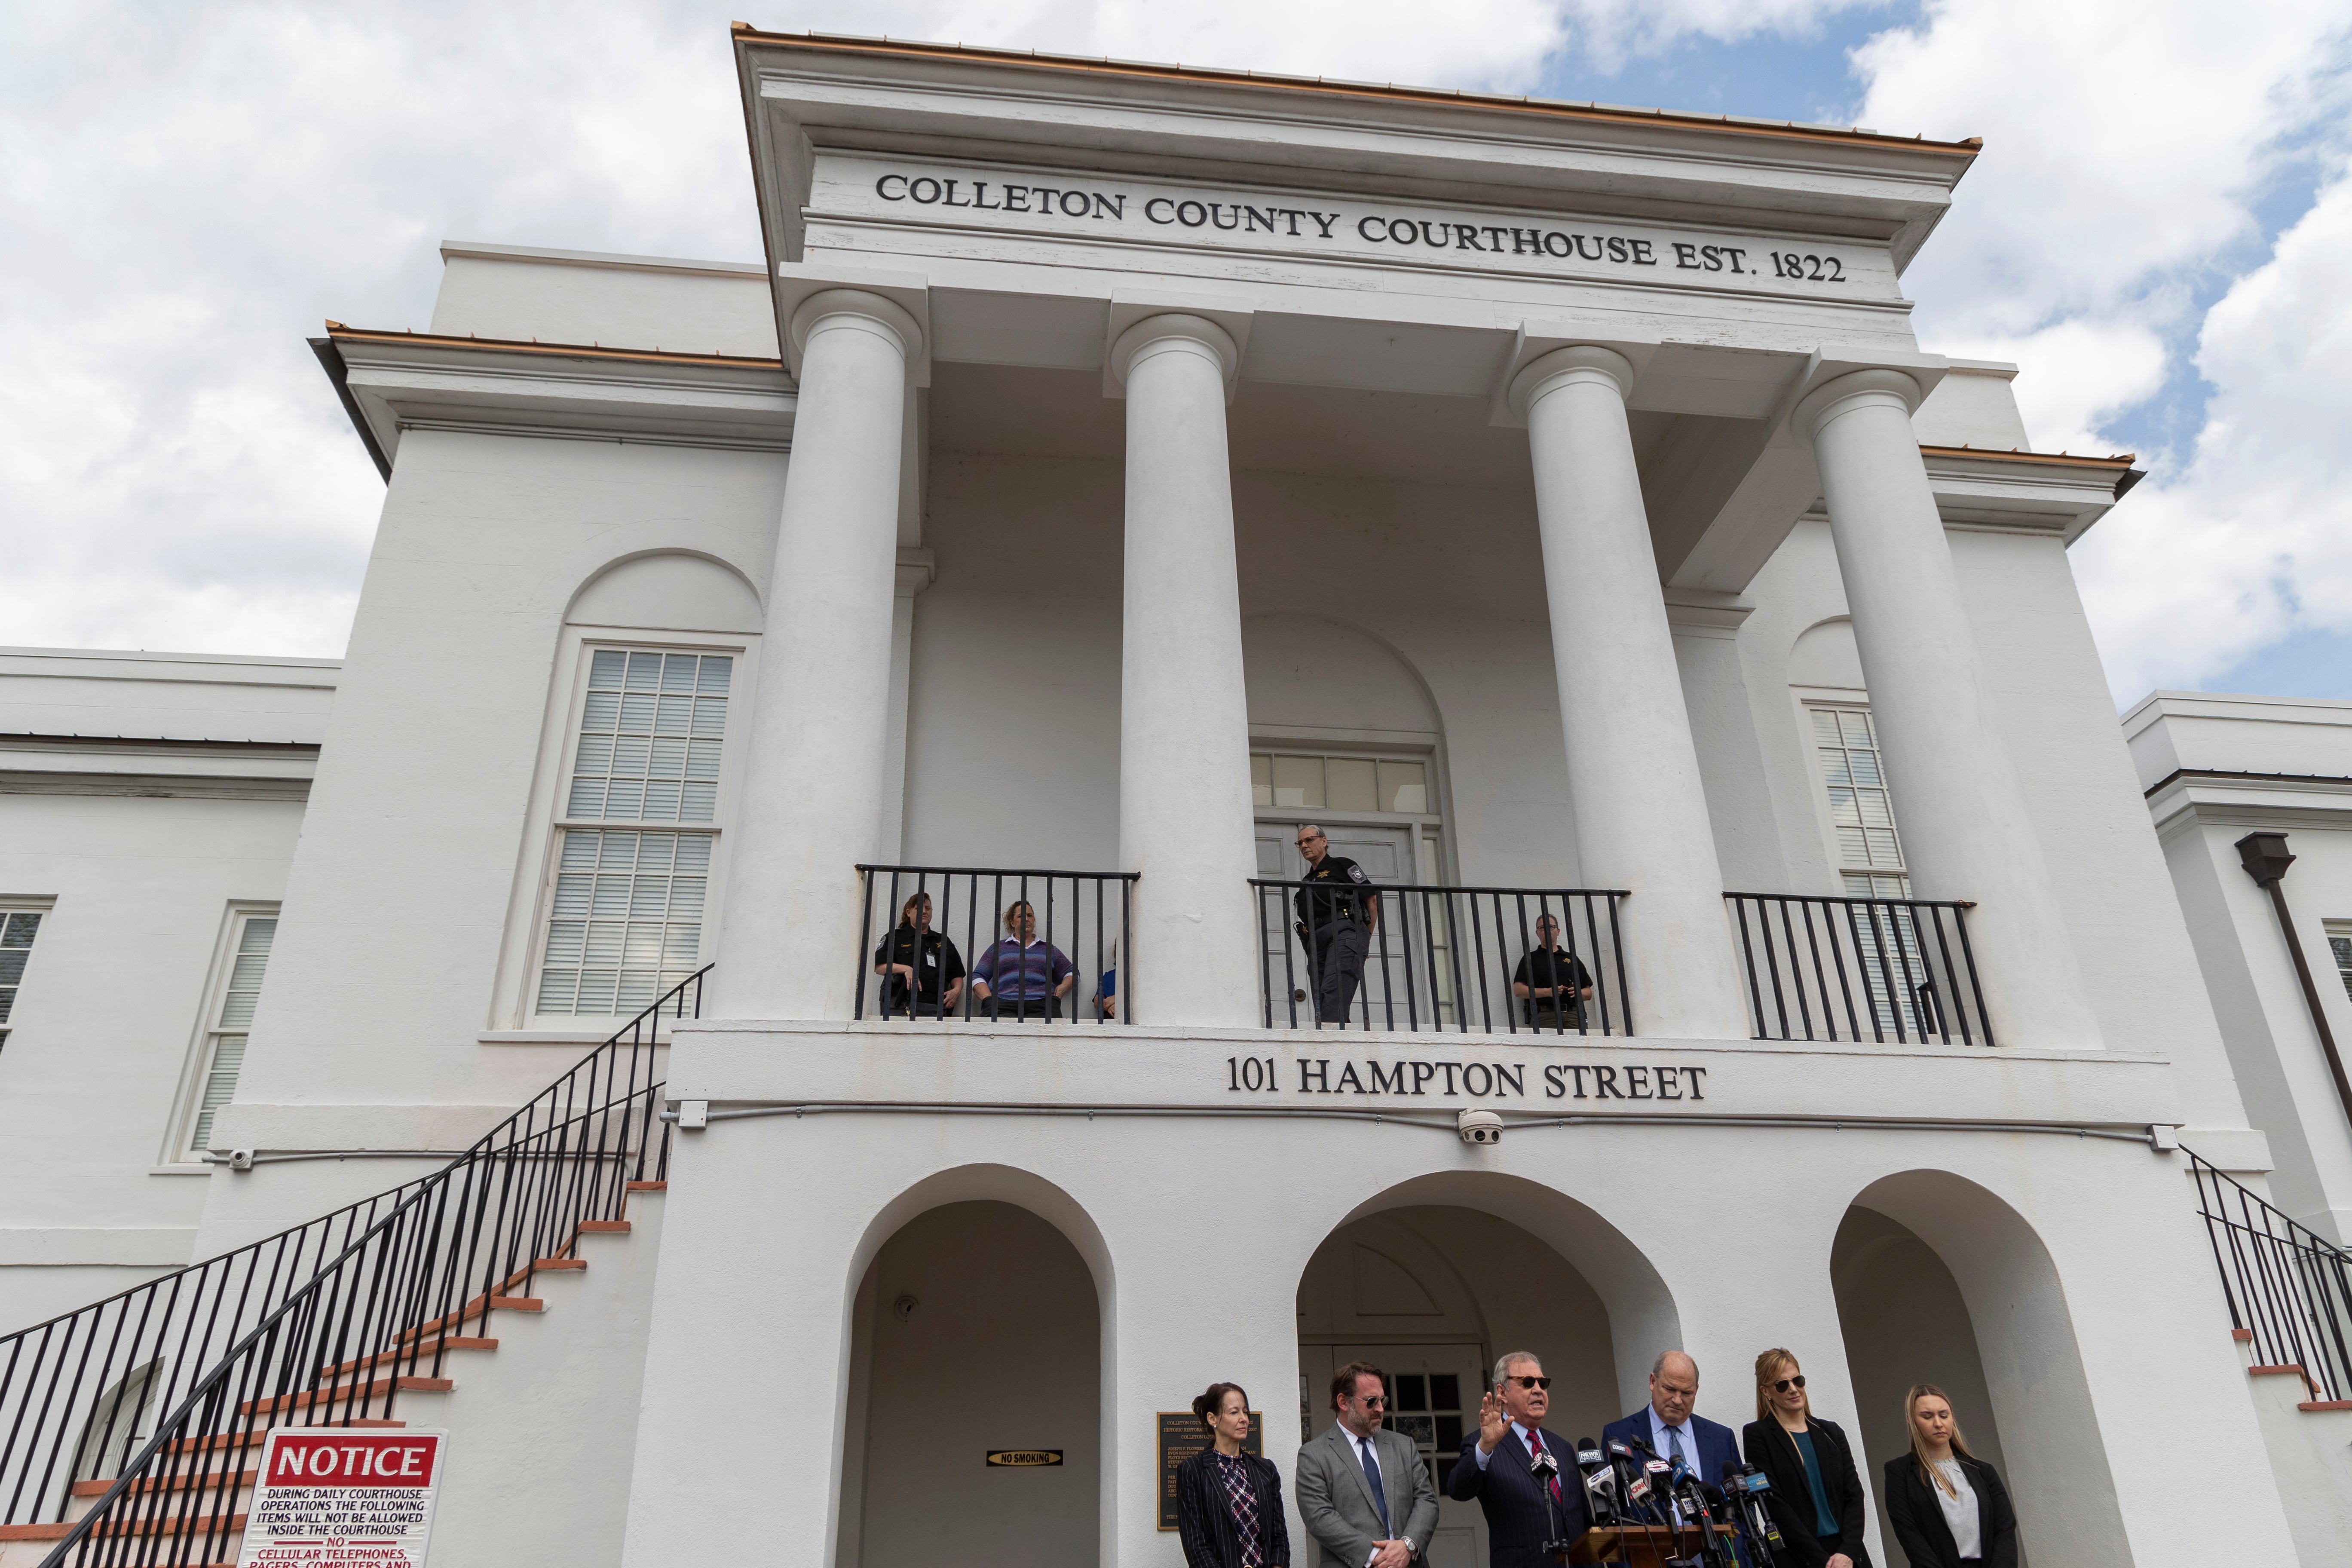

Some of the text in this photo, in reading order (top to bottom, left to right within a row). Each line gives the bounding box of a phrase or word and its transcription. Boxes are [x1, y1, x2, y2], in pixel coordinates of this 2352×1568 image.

[876, 174, 1847, 282] COLLETON COUNTY COURTHOUSE EST. 1822
[1227, 1056, 1707, 1099] 101 HAMPTON STREET
[276, 1446, 426, 1476] NOTICE
[1001, 1453, 1050, 1463] NO SMOKING
[1632, 1482, 1645, 1494] CNN
[267, 1489, 423, 1499] DURING DAILY COURTHOUSE
[260, 1501, 425, 1511] OPERATIONS THE FOLLOWING
[257, 1513, 423, 1523] ITEMS WILL NOT BE ALLOWED
[267, 1525, 408, 1535] INSIDE THE COURTHOUSE
[327, 1537, 344, 1547] NO
[258, 1549, 407, 1561] CELLULAR TELEPHONES,
